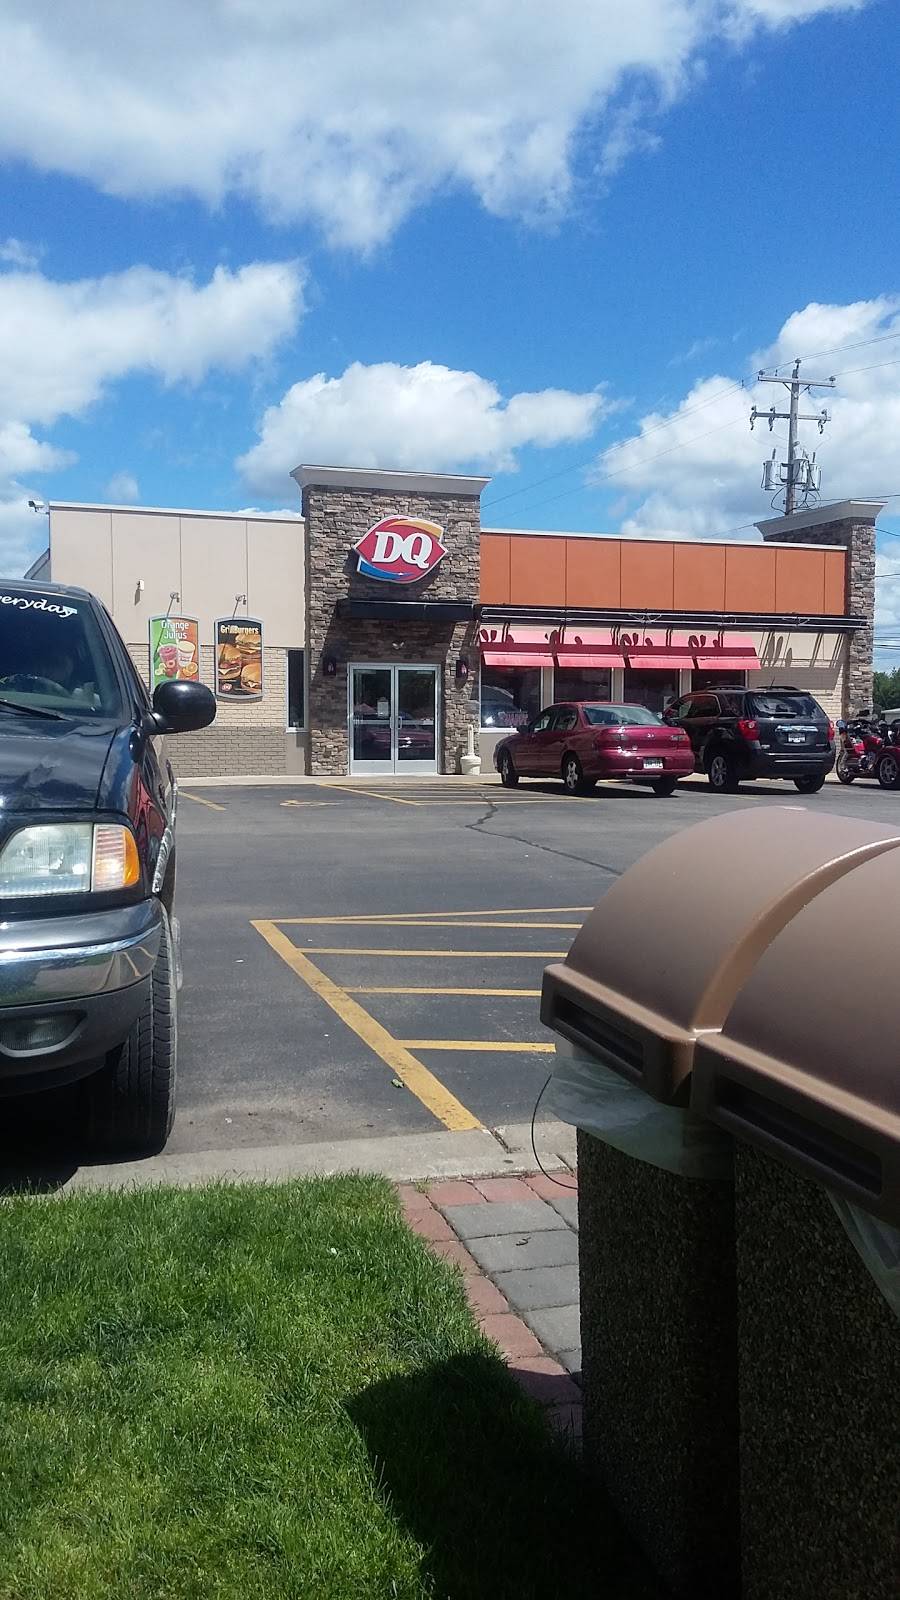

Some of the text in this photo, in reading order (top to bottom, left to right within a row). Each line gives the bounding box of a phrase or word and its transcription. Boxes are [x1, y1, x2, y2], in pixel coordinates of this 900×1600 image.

[372, 531, 432, 569] DQ
[0, 595, 75, 618] eryday
[161, 619, 190, 631] Orange
[163, 630, 188, 640] Julius
